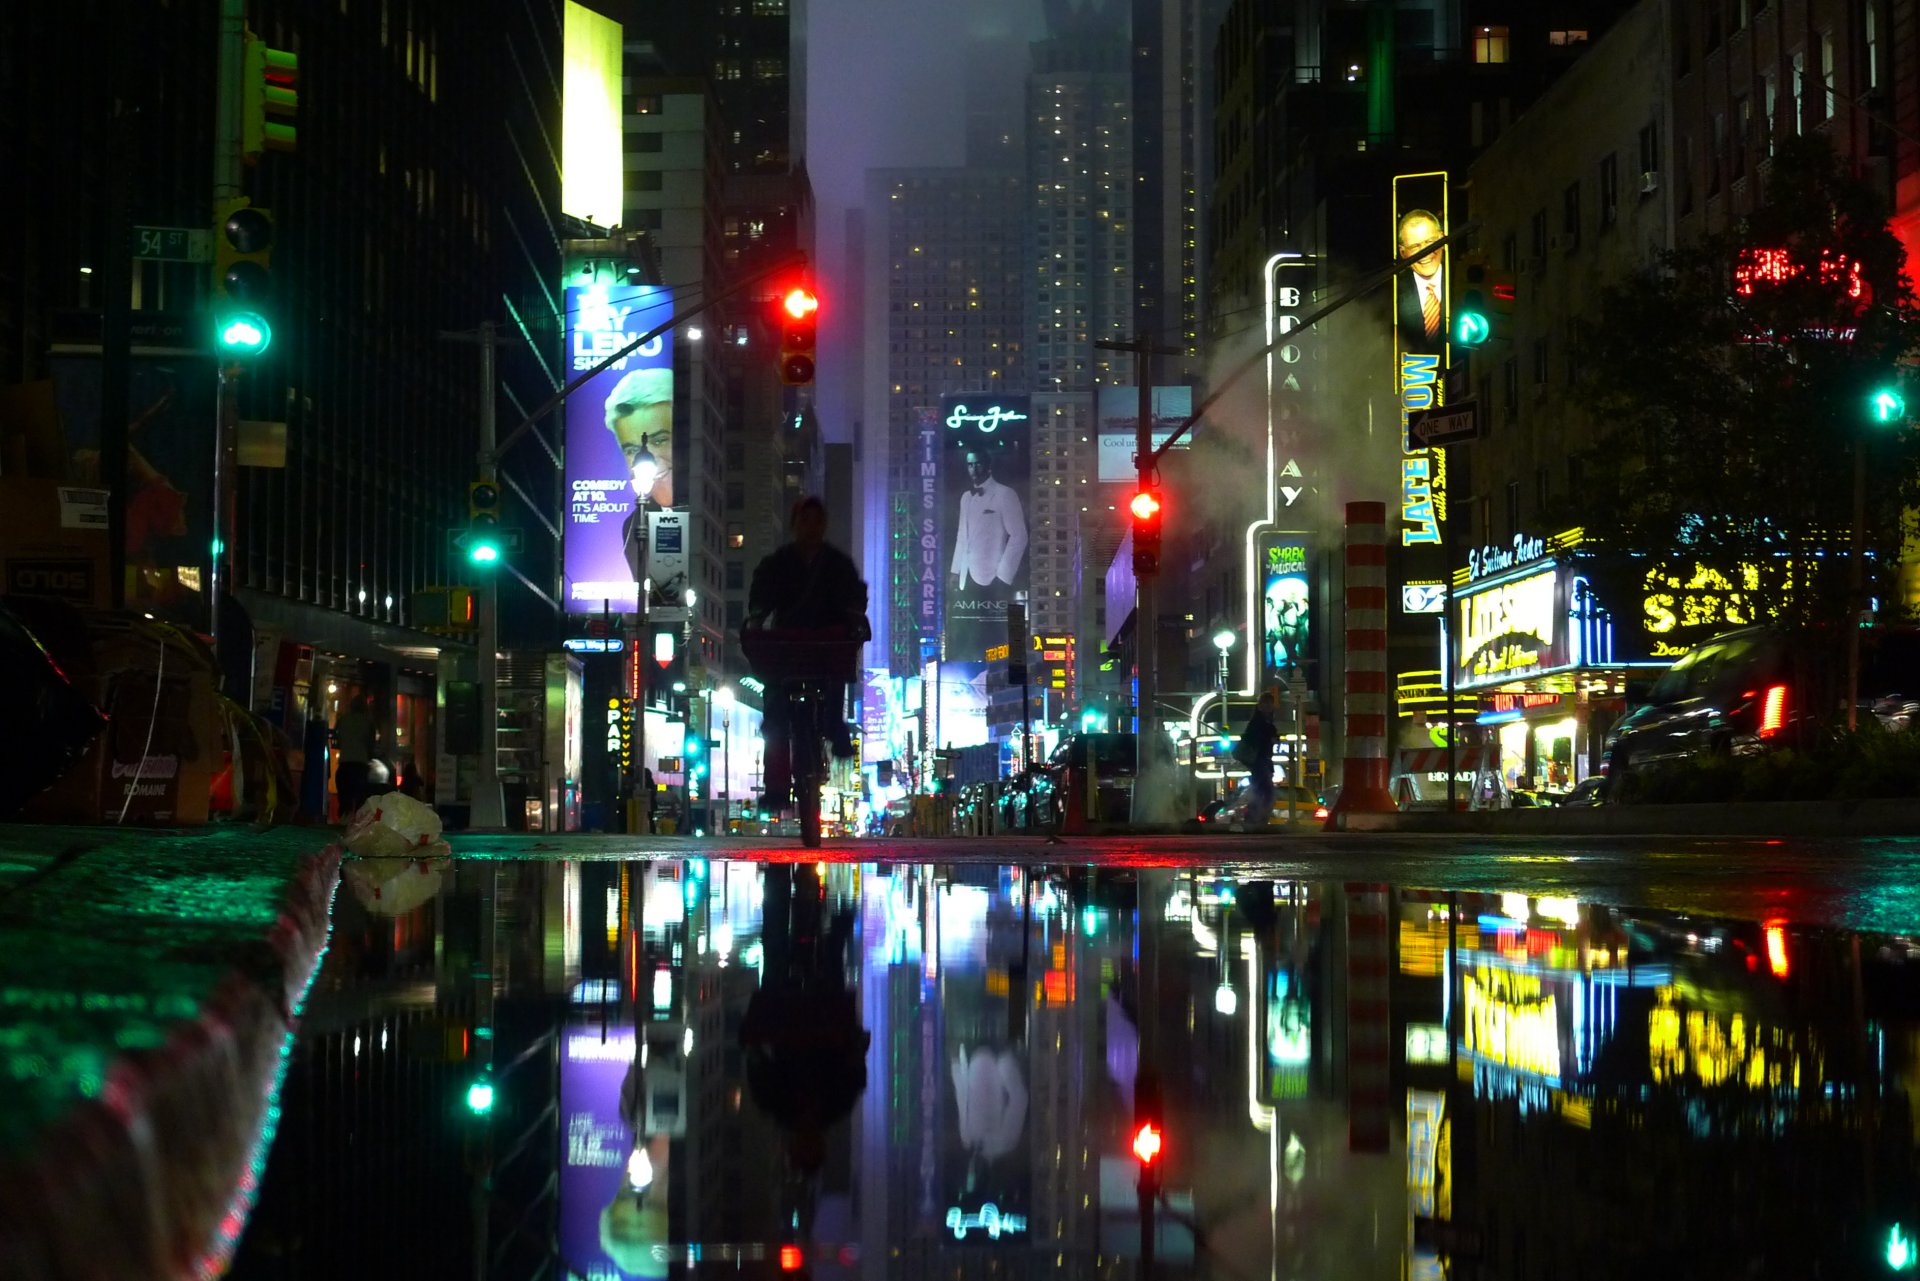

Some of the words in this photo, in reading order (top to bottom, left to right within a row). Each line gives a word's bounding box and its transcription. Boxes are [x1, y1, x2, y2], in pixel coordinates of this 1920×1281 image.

[140, 230, 162, 256] 54
[168, 232, 184, 245] ST
[573, 332, 663, 357] LENO
[1420, 419, 1439, 437] ONE
[1448, 414, 1469, 431] WAY
[1103, 438, 1125, 448] Cool
[920, 430, 936, 509] TIMES
[1432, 447, 1447, 489] David
[572, 480, 627, 490] COMEDY
[572, 491, 590, 501] AT
[1402, 457, 1442, 547] LATE
[572, 503, 591, 512] IT'S
[592, 503, 629, 512] ABOUT
[572, 513, 600, 523] TIME.
[1269, 546, 1306, 563] SHREK
[921, 518, 936, 615] SQUARE
[1270, 561, 1306, 574] MUSICAL
[953, 600, 975, 609] AM
[1461, 588, 1504, 668] LATE
